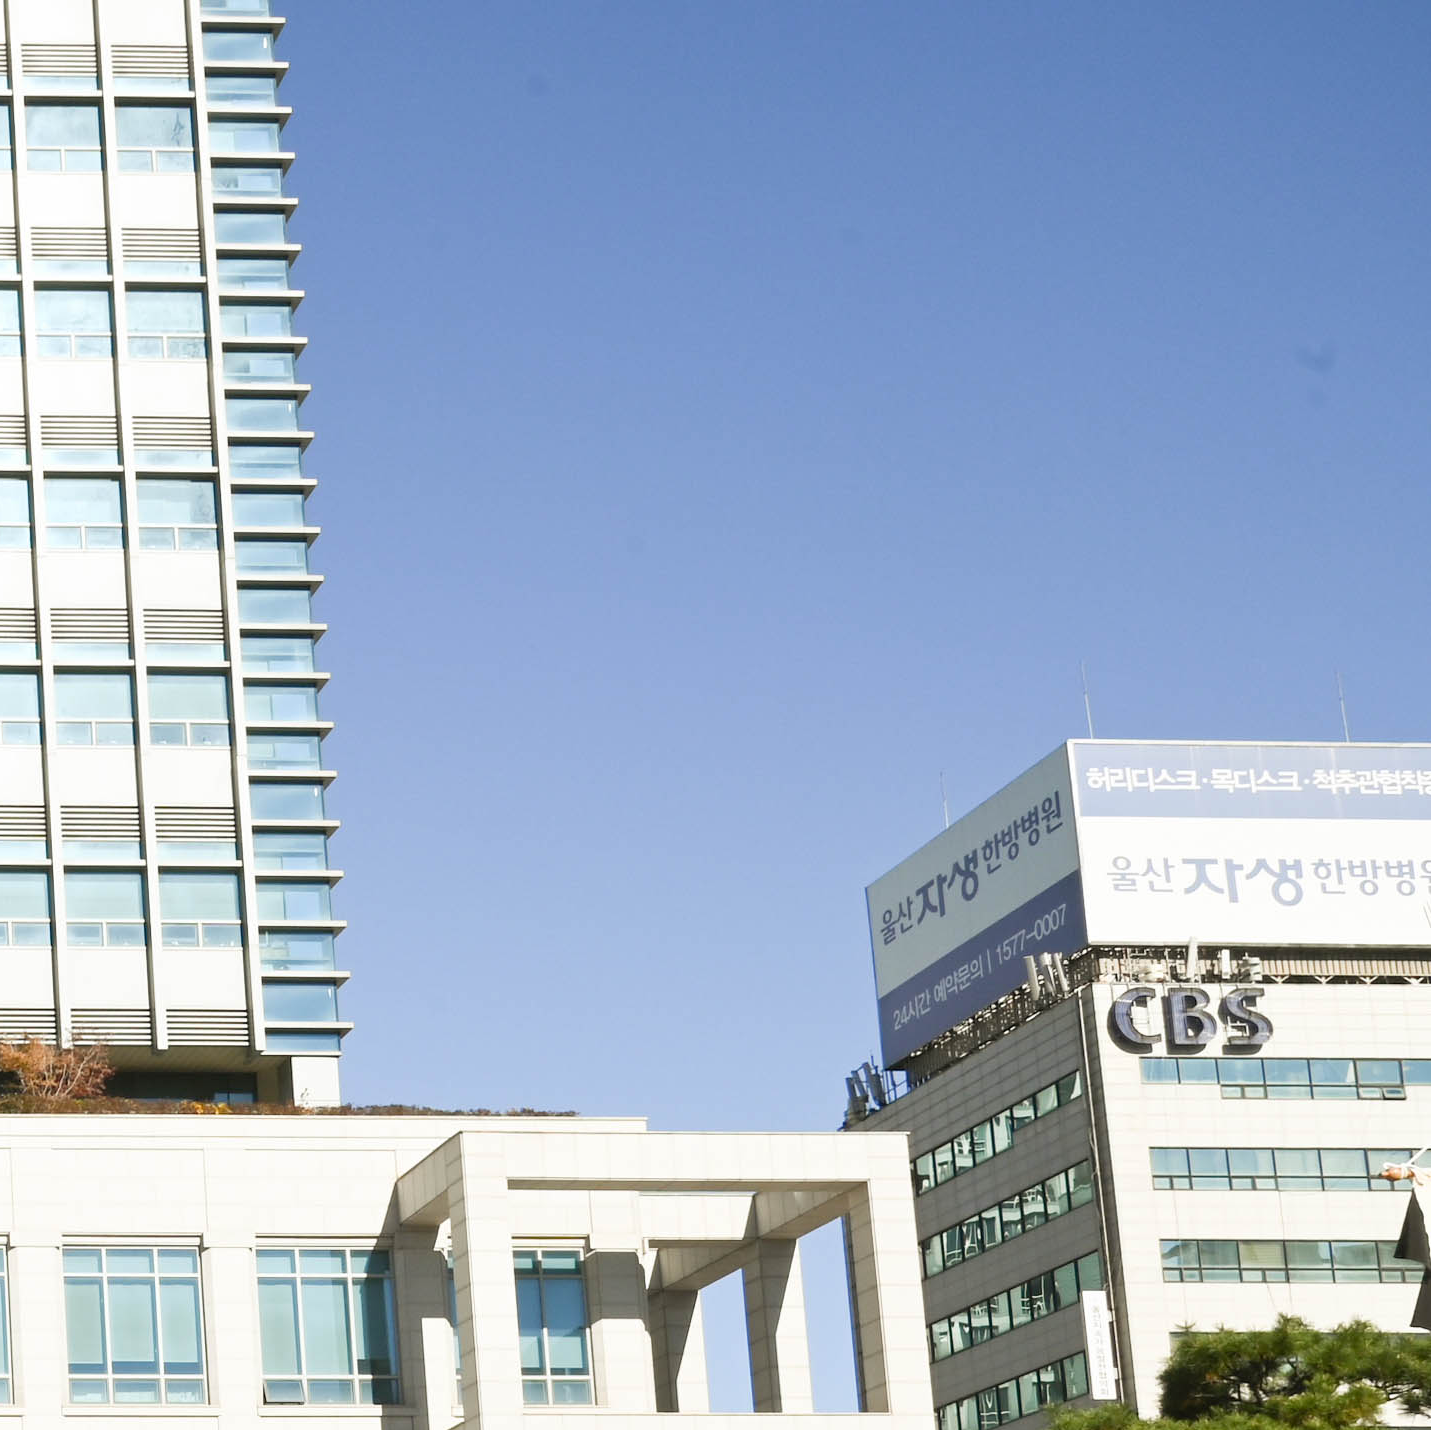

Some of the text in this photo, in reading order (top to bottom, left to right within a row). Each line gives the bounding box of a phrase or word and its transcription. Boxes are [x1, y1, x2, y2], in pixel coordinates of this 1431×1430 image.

[893, 990, 932, 1031] 24시간
[996, 903, 1068, 965] 1577-0007
[1109, 987, 1273, 1050] CBS
